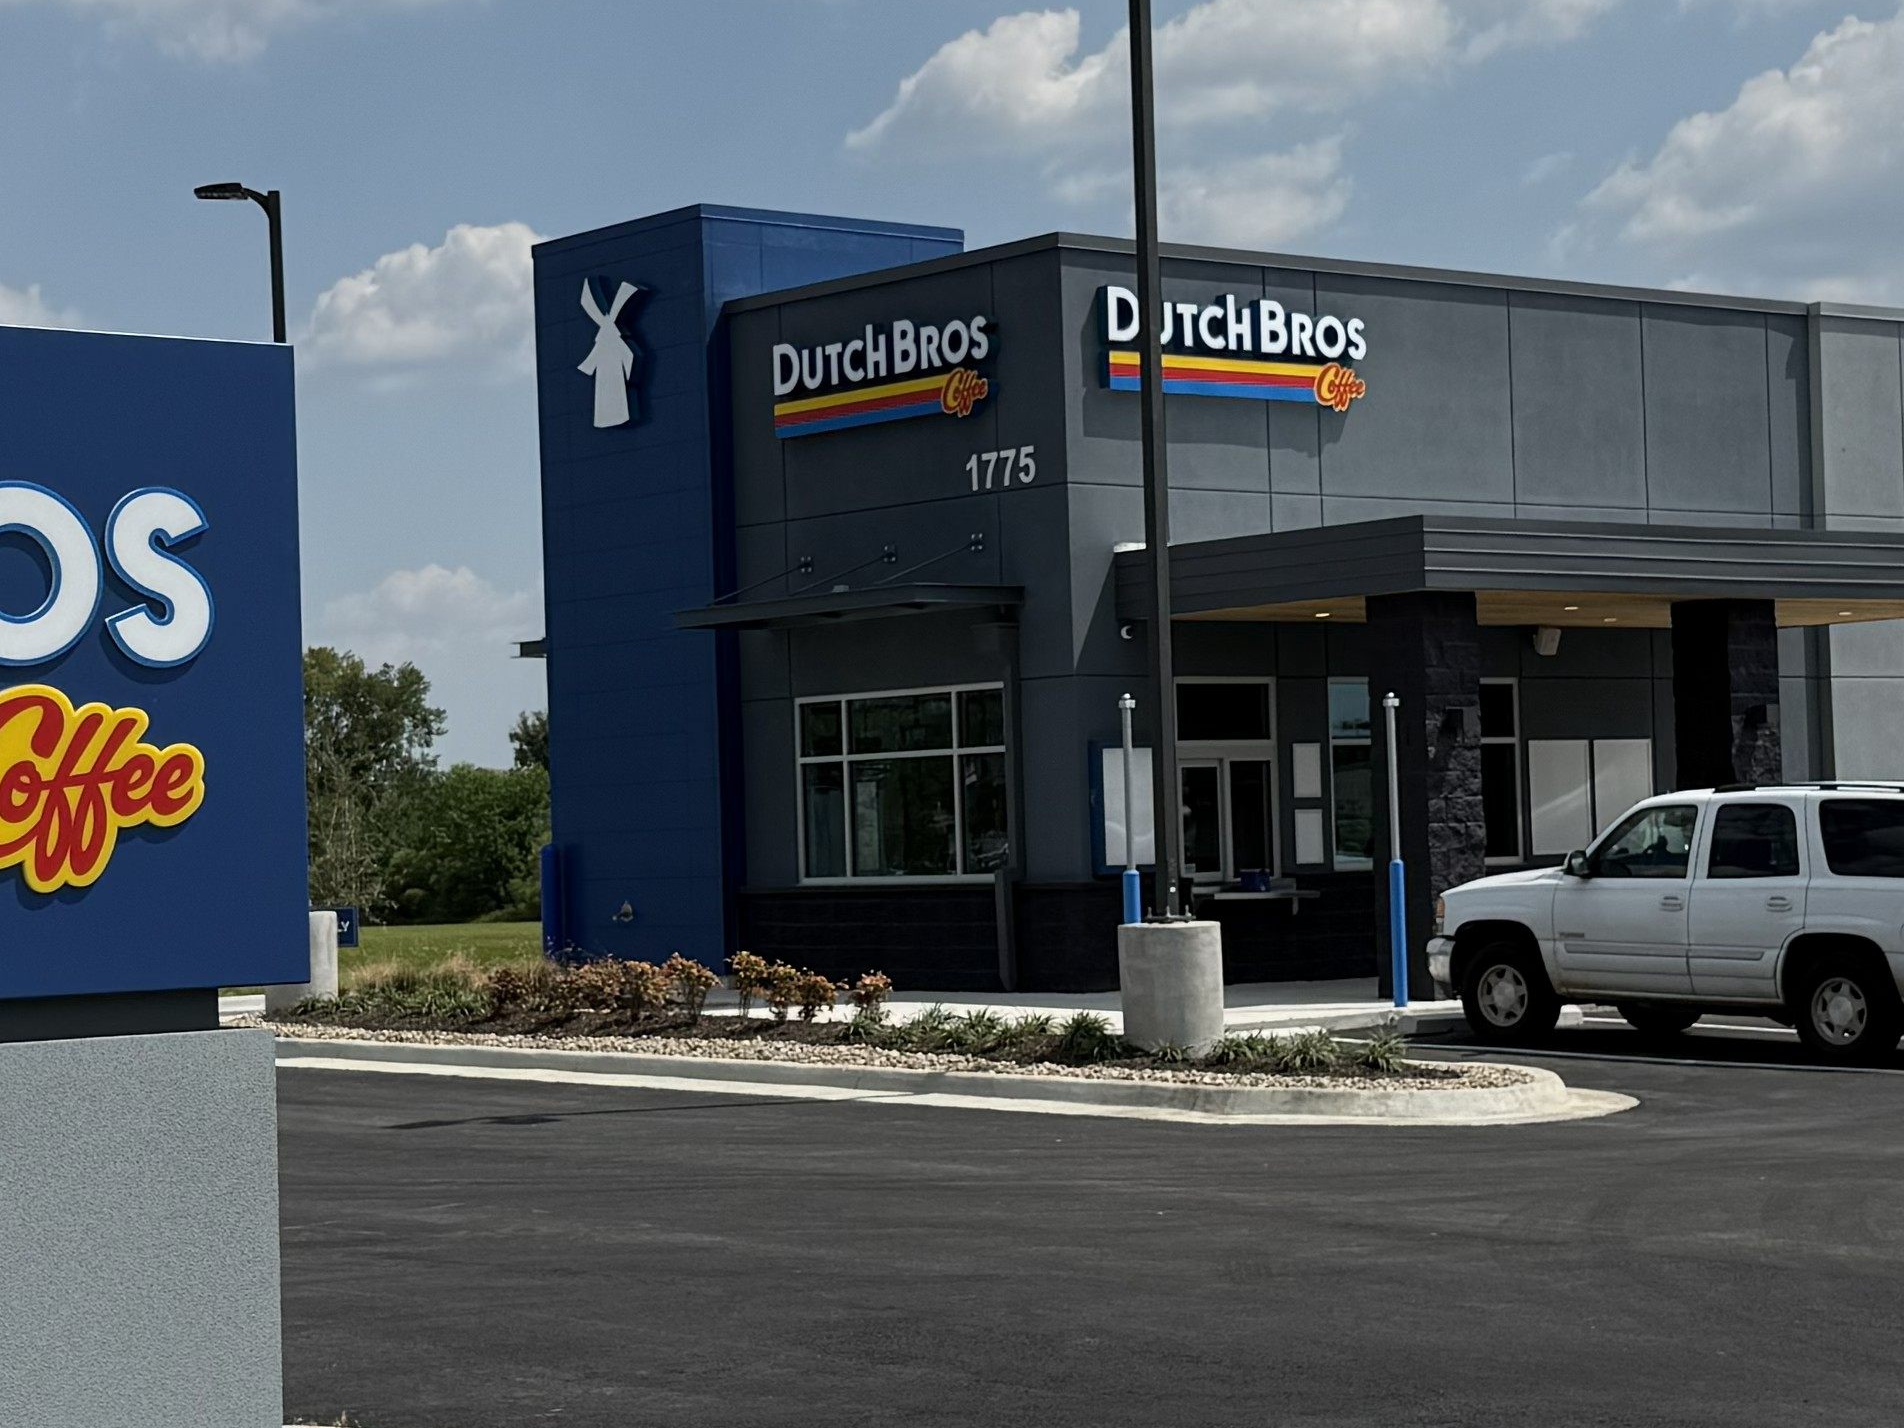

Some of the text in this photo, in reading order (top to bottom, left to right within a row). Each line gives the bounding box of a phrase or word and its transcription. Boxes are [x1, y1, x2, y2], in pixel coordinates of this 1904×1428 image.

[1259, 299, 1367, 360] BROS
[773, 315, 989, 396] DUTCH BROS
[942, 369, 987, 415] Coffee
[1315, 363, 1365, 408] Coffee
[966, 445, 1036, 491] 1775
